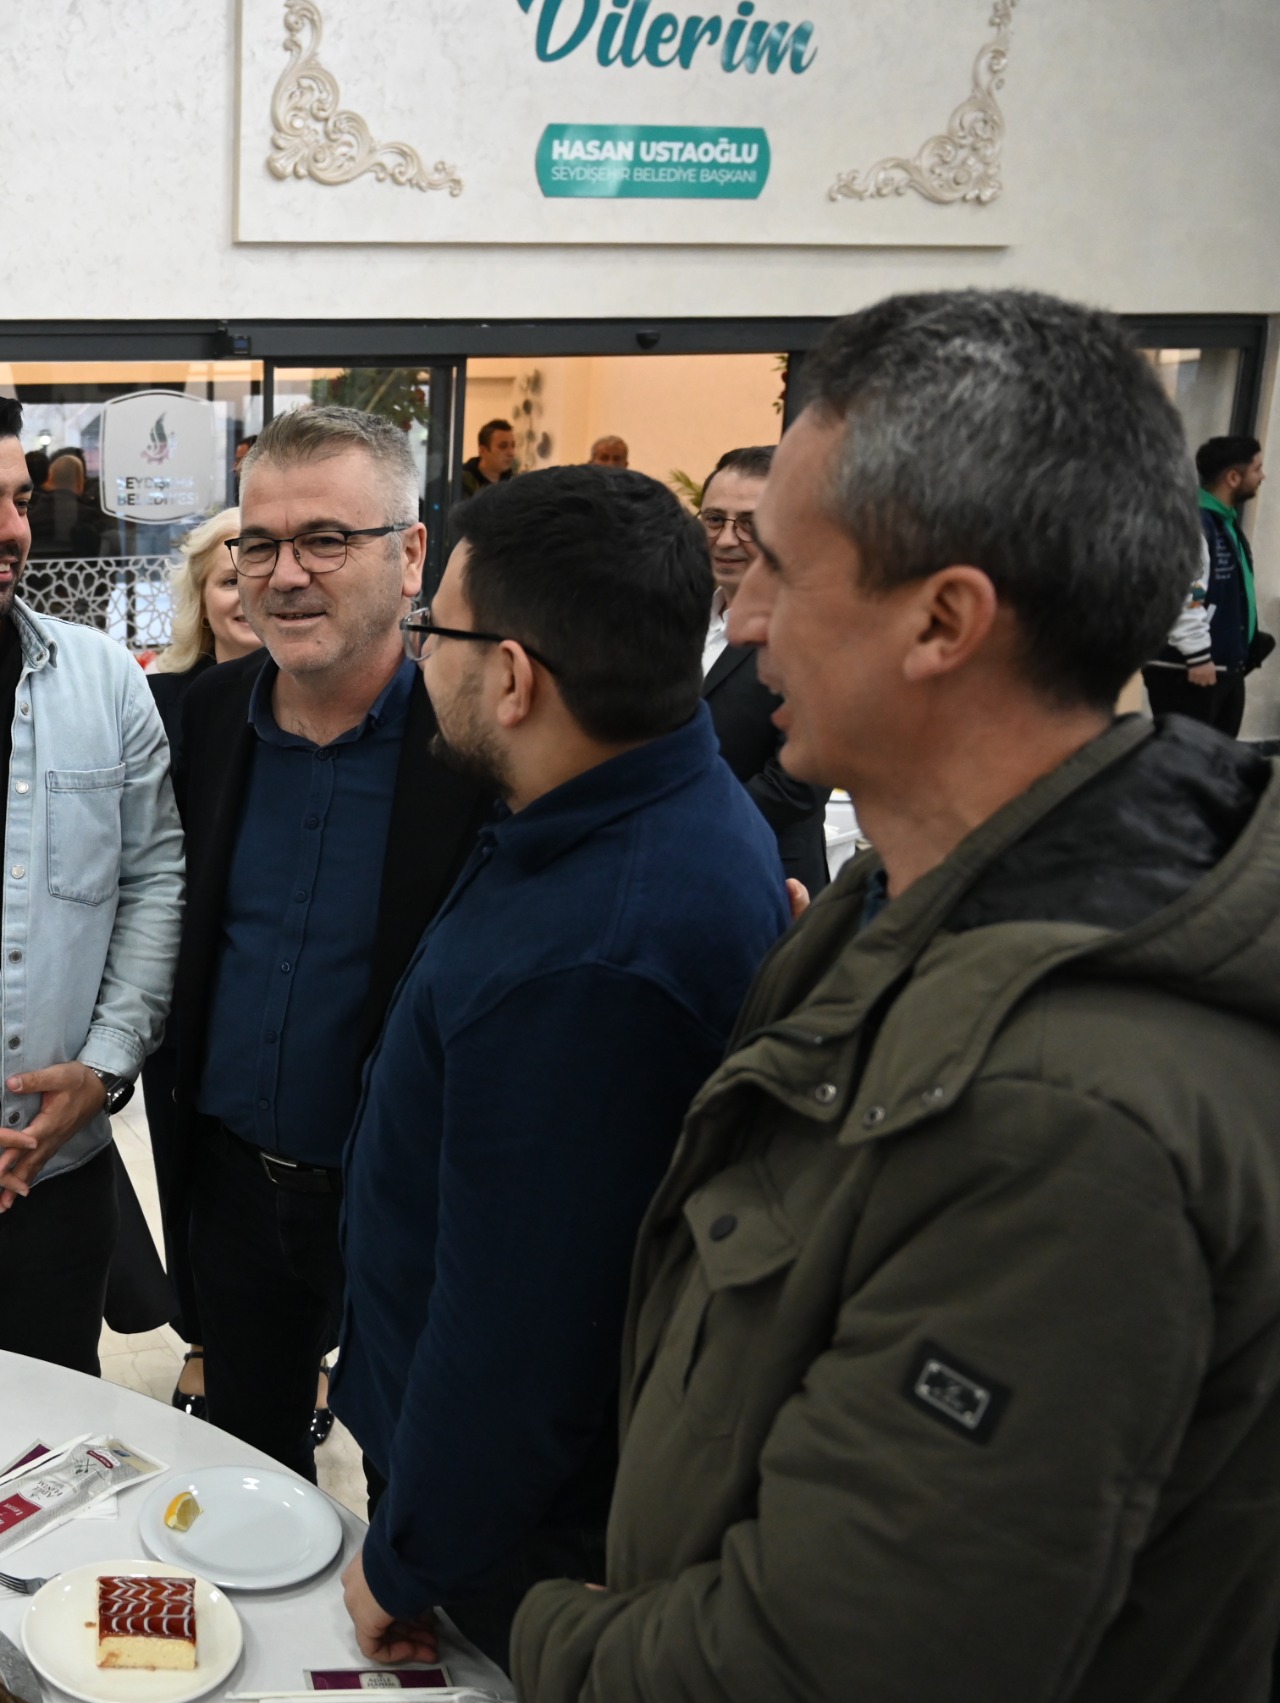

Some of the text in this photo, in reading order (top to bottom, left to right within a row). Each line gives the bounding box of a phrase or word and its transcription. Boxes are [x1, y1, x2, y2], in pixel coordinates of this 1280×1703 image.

[517, 0, 818, 75] Dilerim
[551, 137, 759, 164] HASAN USTAOĞLU
[633, 166, 697, 183] BELEDİYE
[700, 168, 757, 186] BAŞKANI
